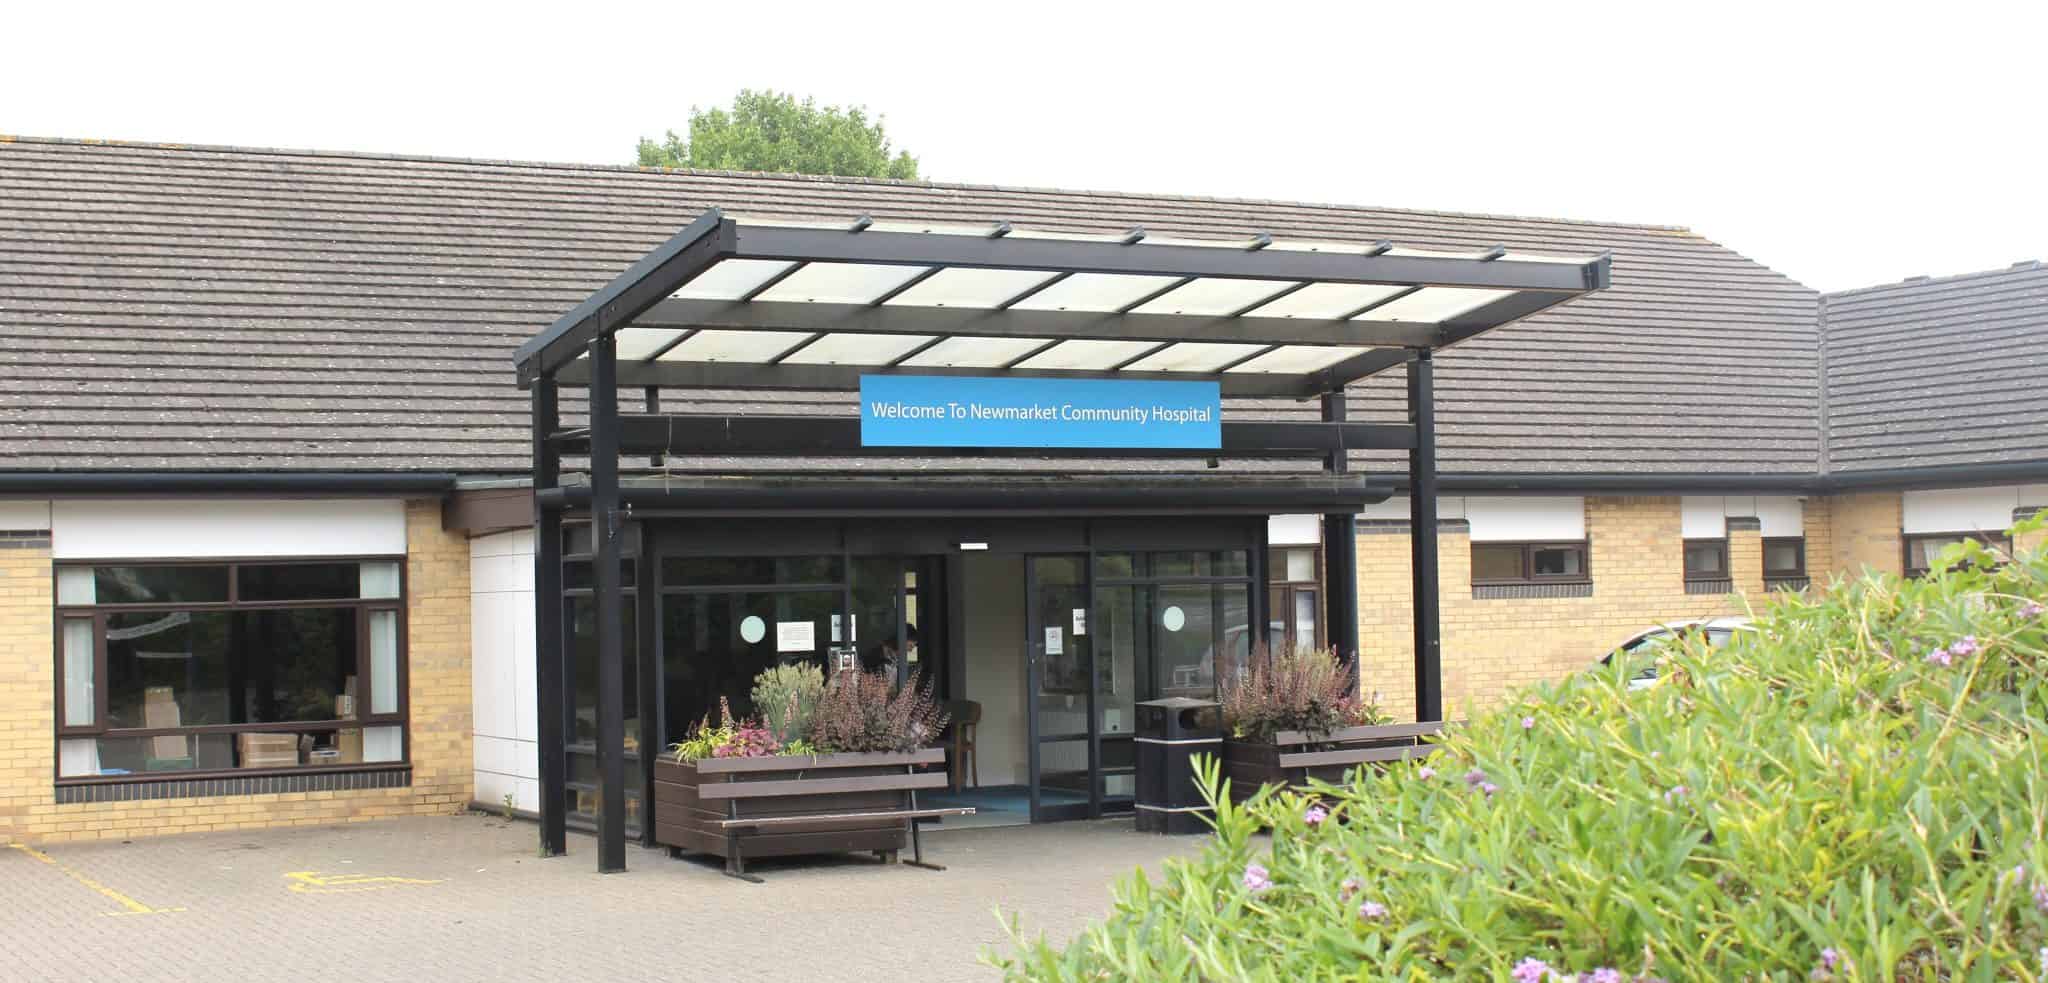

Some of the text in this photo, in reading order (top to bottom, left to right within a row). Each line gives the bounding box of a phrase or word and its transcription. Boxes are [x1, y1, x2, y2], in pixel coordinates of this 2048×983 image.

[871, 401, 1211, 426] Welcome To Newmarket Community Hospital
